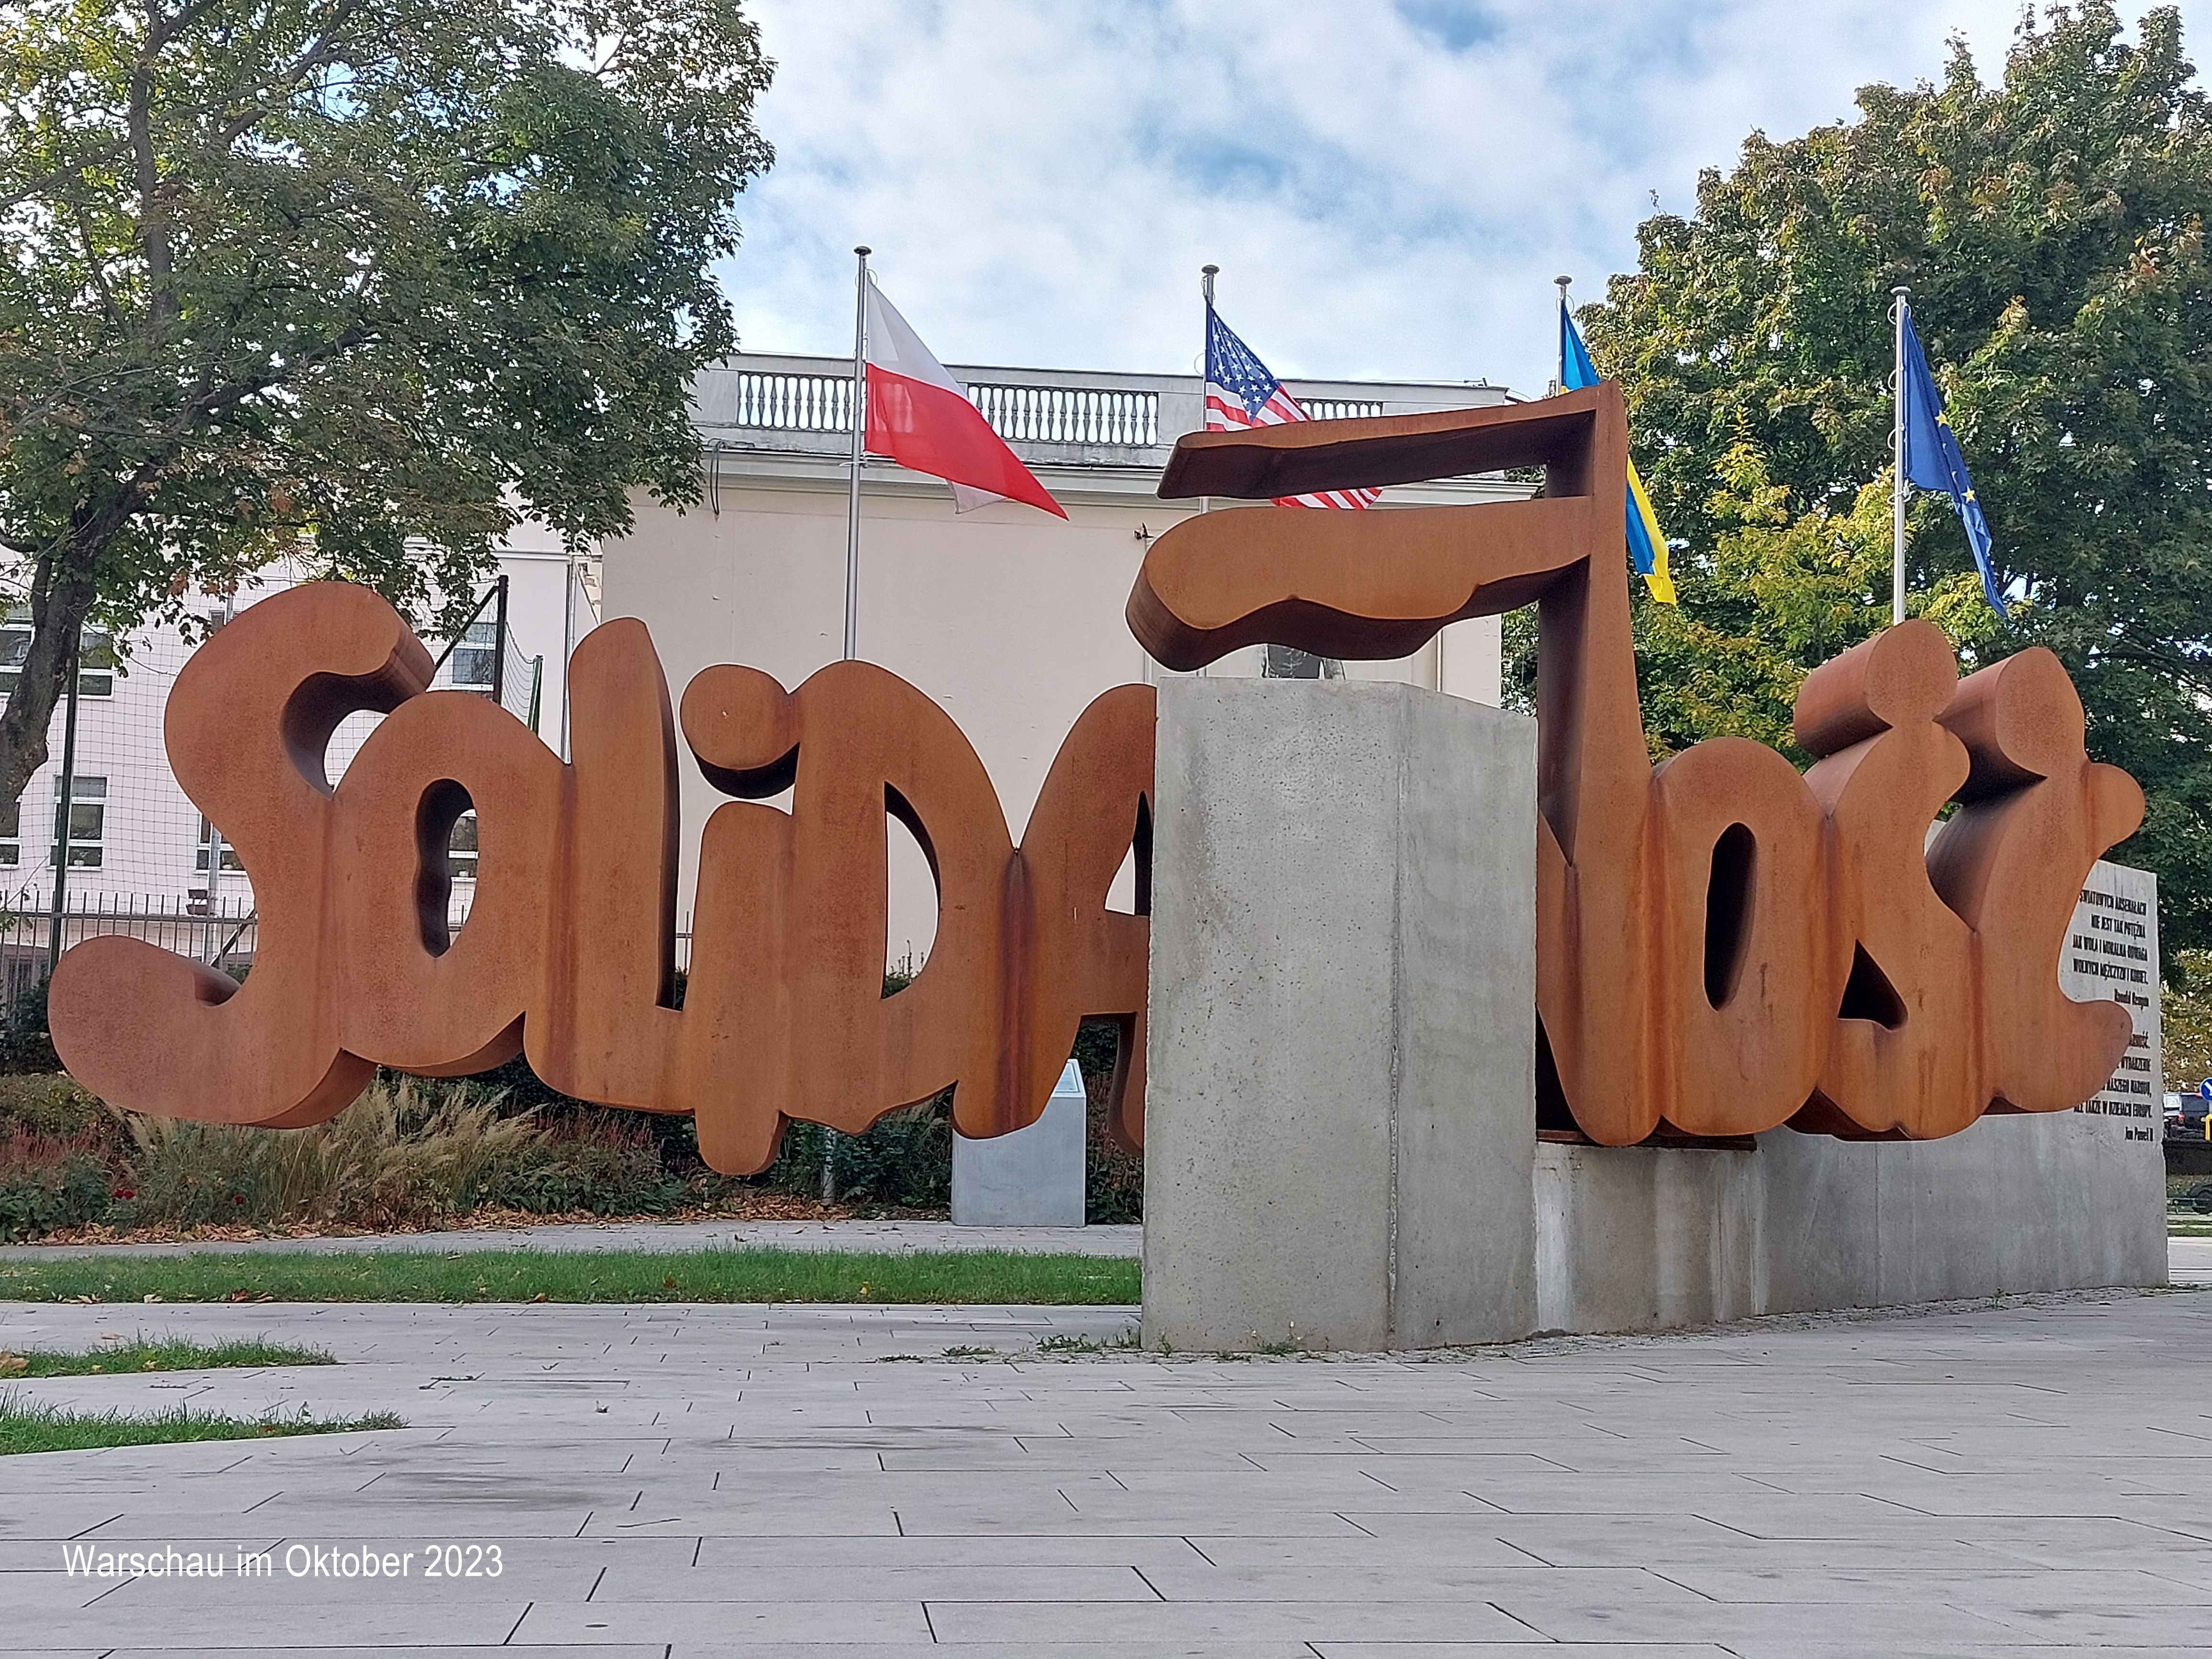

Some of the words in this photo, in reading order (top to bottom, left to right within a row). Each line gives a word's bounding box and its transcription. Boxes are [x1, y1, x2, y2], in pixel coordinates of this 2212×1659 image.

[2101, 916, 2112, 931] JEST
[2114, 919, 2124, 933] TAK
[2072, 934, 2082, 950] JAK
